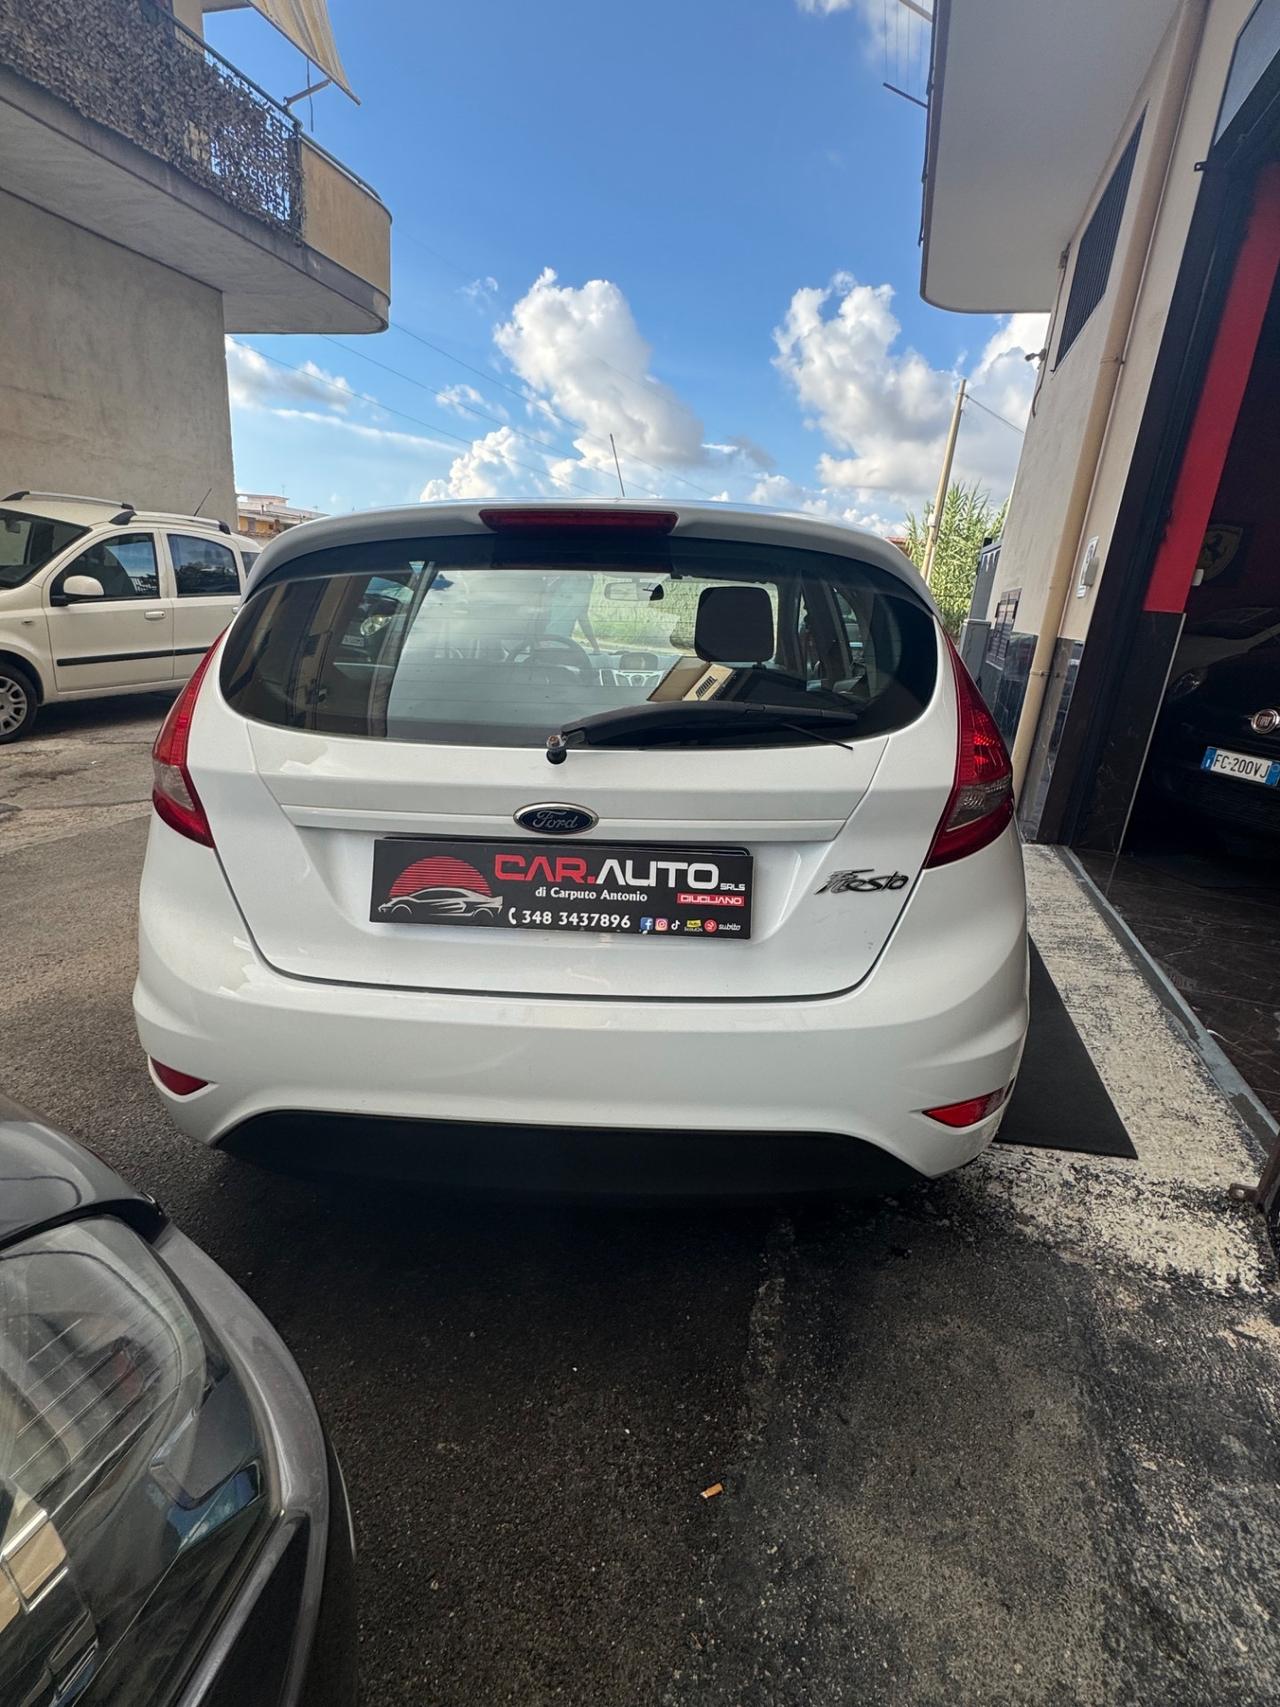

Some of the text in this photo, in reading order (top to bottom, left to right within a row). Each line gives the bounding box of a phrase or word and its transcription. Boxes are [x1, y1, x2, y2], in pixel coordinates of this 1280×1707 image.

[532, 810, 579, 829] Ford
[535, 886, 648, 902] di Carputo Antonio
[720, 883, 746, 891] SRLS
[522, 910, 552, 925] 348
[558, 912, 631, 928] 3437896
[718, 922, 742, 931] subito
